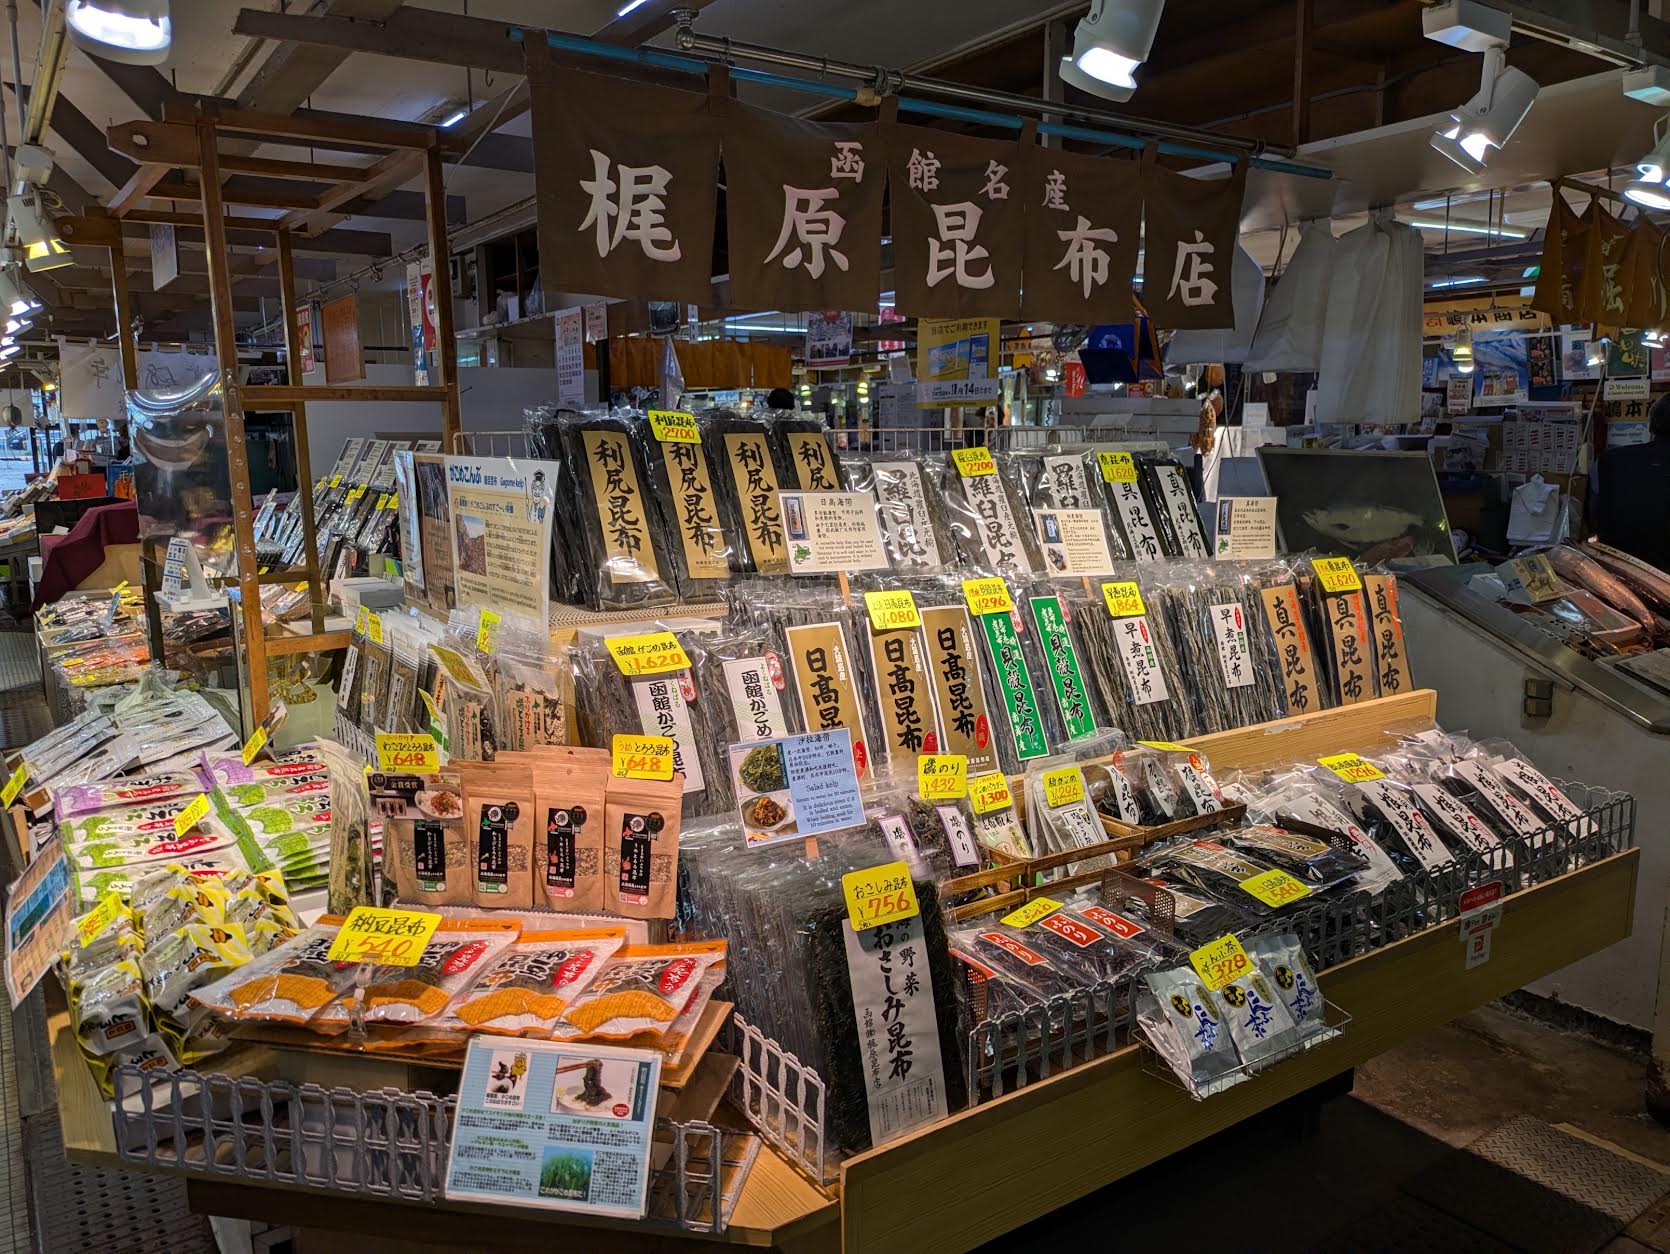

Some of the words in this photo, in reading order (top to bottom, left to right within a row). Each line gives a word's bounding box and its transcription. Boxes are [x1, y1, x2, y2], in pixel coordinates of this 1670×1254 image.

[577, 148, 1219, 308] 梶原昆布店
[797, 440, 835, 490] 利尻
[1101, 453, 1130, 466] 真昆布
[592, 438, 643, 556] 利尻昆布
[669, 442, 715, 557] 利尻昆布
[734, 440, 783, 556] 利尻昆布
[1166, 470, 1203, 559] 真昆布
[1124, 622, 1152, 700] 早煮昆布
[1220, 608, 1242, 683] 早煮昆布
[1272, 596, 1309, 715] 真昆布
[1334, 598, 1363, 704] 真昆布
[1374, 583, 1400, 696] 真昆布
[741, 669, 774, 738] 函館がごめ
[884, 638, 924, 753] 日高昆布
[937, 627, 976, 739] 日高昆布
[1001, 646, 1034, 750] 貝殻昆布
[1050, 633, 1086, 734] 貝殻昆布
[806, 782, 824, 792] Salad
[825, 780, 840, 790] kelp
[1477, 770, 1533, 828] 根昆布
[1518, 770, 1576, 820] 根昆布
[948, 814, 972, 854] 磯のり
[1378, 792, 1435, 854] 根昆布
[1432, 794, 1493, 852] 根昆布
[350, 912, 428, 937] 納豆昆布
[853, 881, 909, 899] おさしみ昆布
[857, 890, 913, 921] ¥756
[1092, 910, 1130, 934] ふのり
[345, 936, 414, 957] ¥540
[1050, 917, 1088, 943] ふのり
[872, 924, 914, 1083] おさしみ昆布
